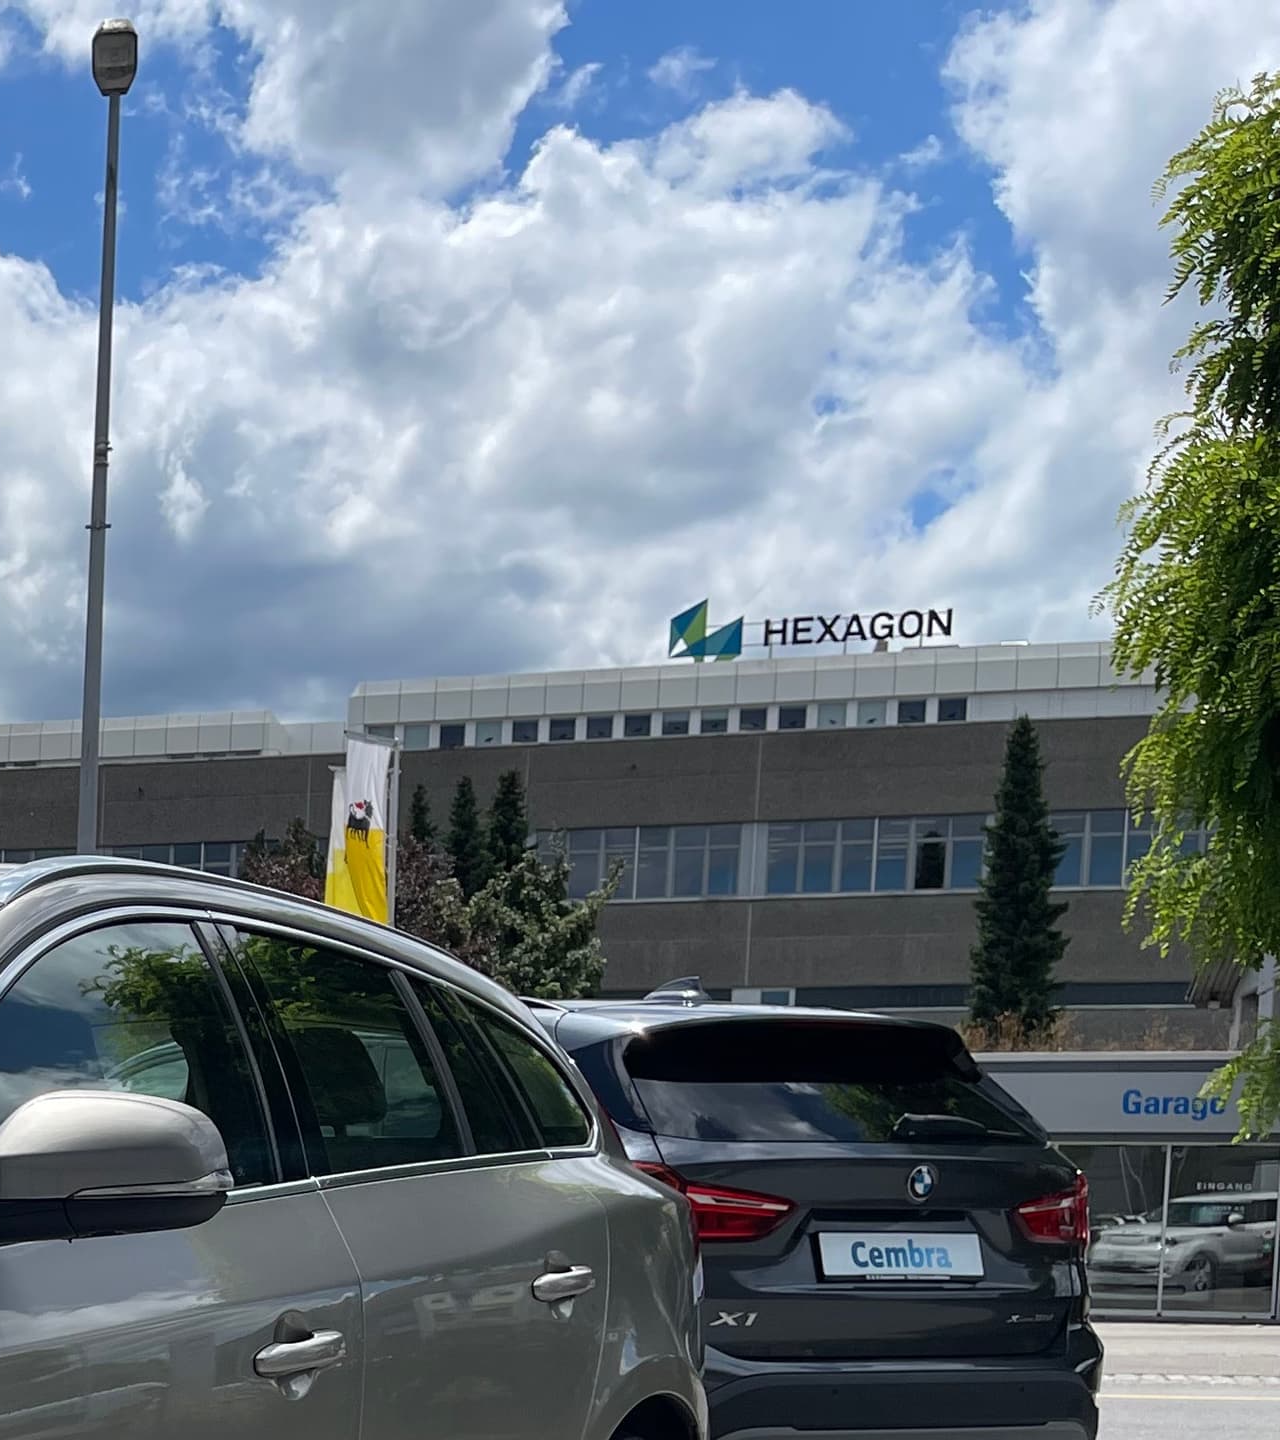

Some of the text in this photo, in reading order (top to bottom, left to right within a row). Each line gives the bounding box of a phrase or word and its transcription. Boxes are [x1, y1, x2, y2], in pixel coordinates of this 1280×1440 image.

[763, 608, 953, 646] HEXAGON
[850, 1238, 953, 1269] Cembra
[709, 1311, 759, 1326] X1
